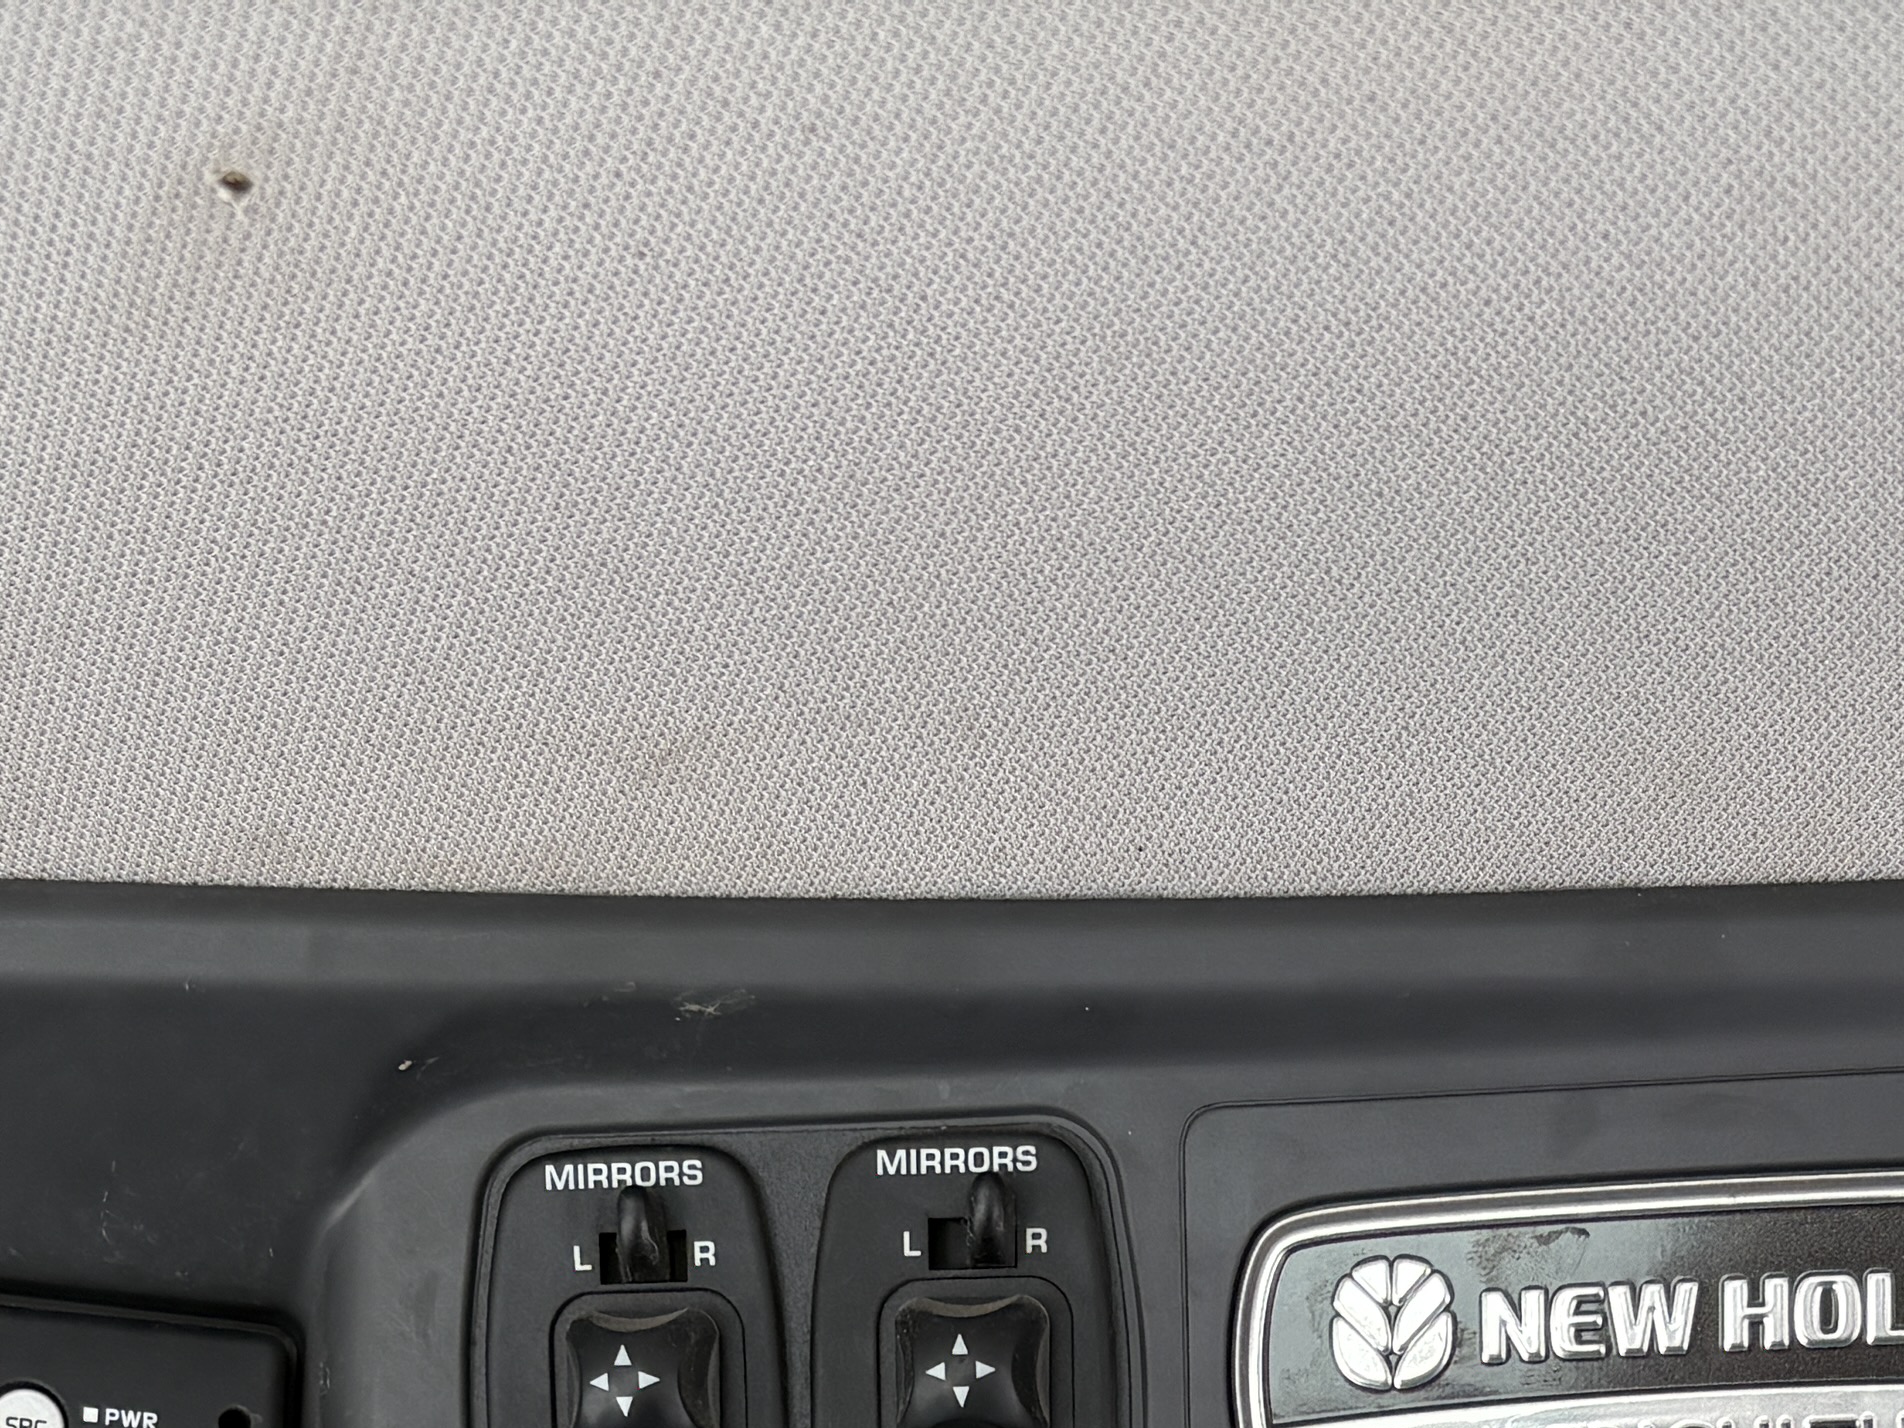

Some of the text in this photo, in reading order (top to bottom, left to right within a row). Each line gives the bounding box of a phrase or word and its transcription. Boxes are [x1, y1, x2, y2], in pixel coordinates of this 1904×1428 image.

[543, 1159, 704, 1191] MIRRORS
[875, 1144, 1037, 1177] MIRRORS
[573, 1241, 716, 1272] L R
[903, 1228, 1048, 1257] L R
[1480, 1276, 1698, 1365] NEW
